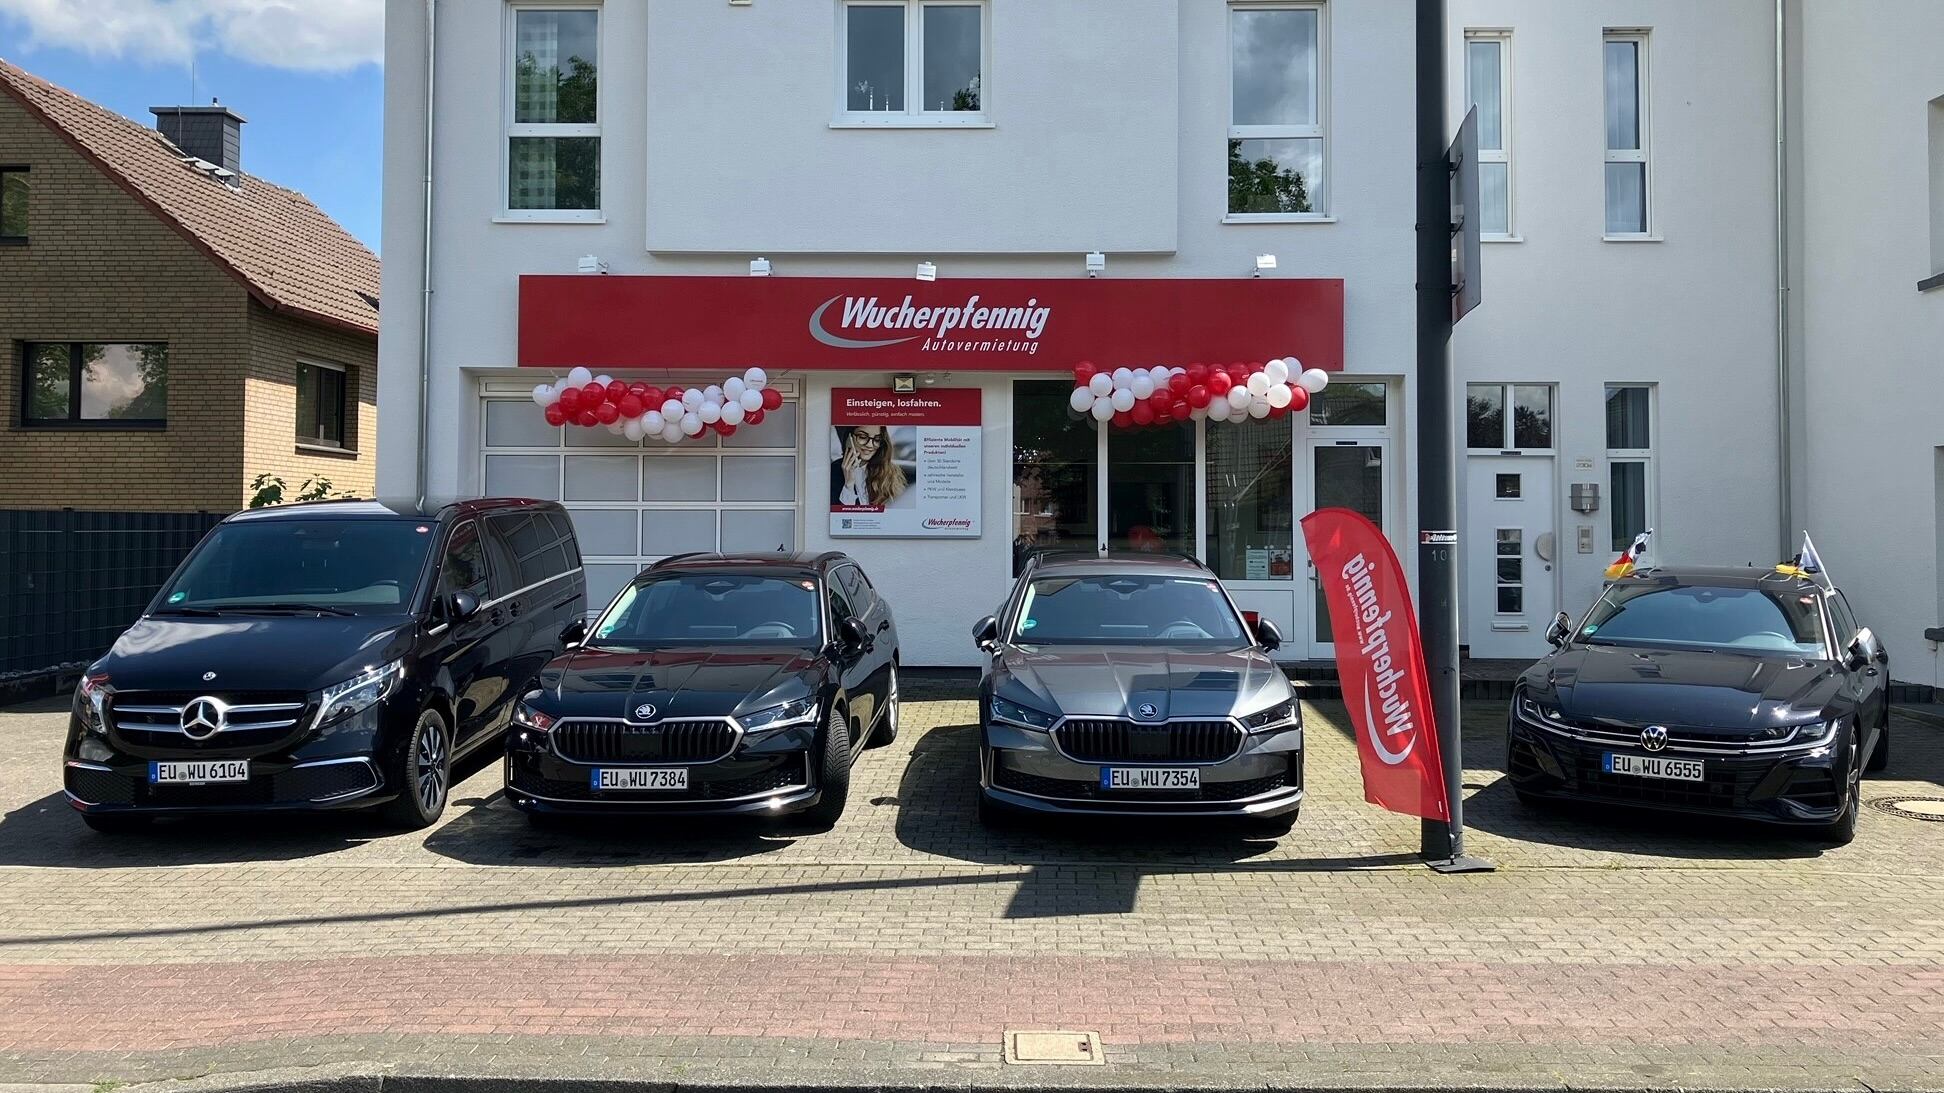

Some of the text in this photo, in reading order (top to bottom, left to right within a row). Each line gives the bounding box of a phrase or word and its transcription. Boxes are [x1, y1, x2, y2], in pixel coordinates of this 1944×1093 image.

[841, 295, 1051, 339] Wucherpfennig
[921, 337, 1039, 355] Autovermietung
[846, 398, 942, 408] Einsteigen, losfahren.
[928, 518, 971, 528] Wucherpfennig
[159, 764, 177, 780] EU
[1613, 756, 1631, 772] EU
[601, 771, 619, 787] EU
[1111, 770, 1130, 786] EU
